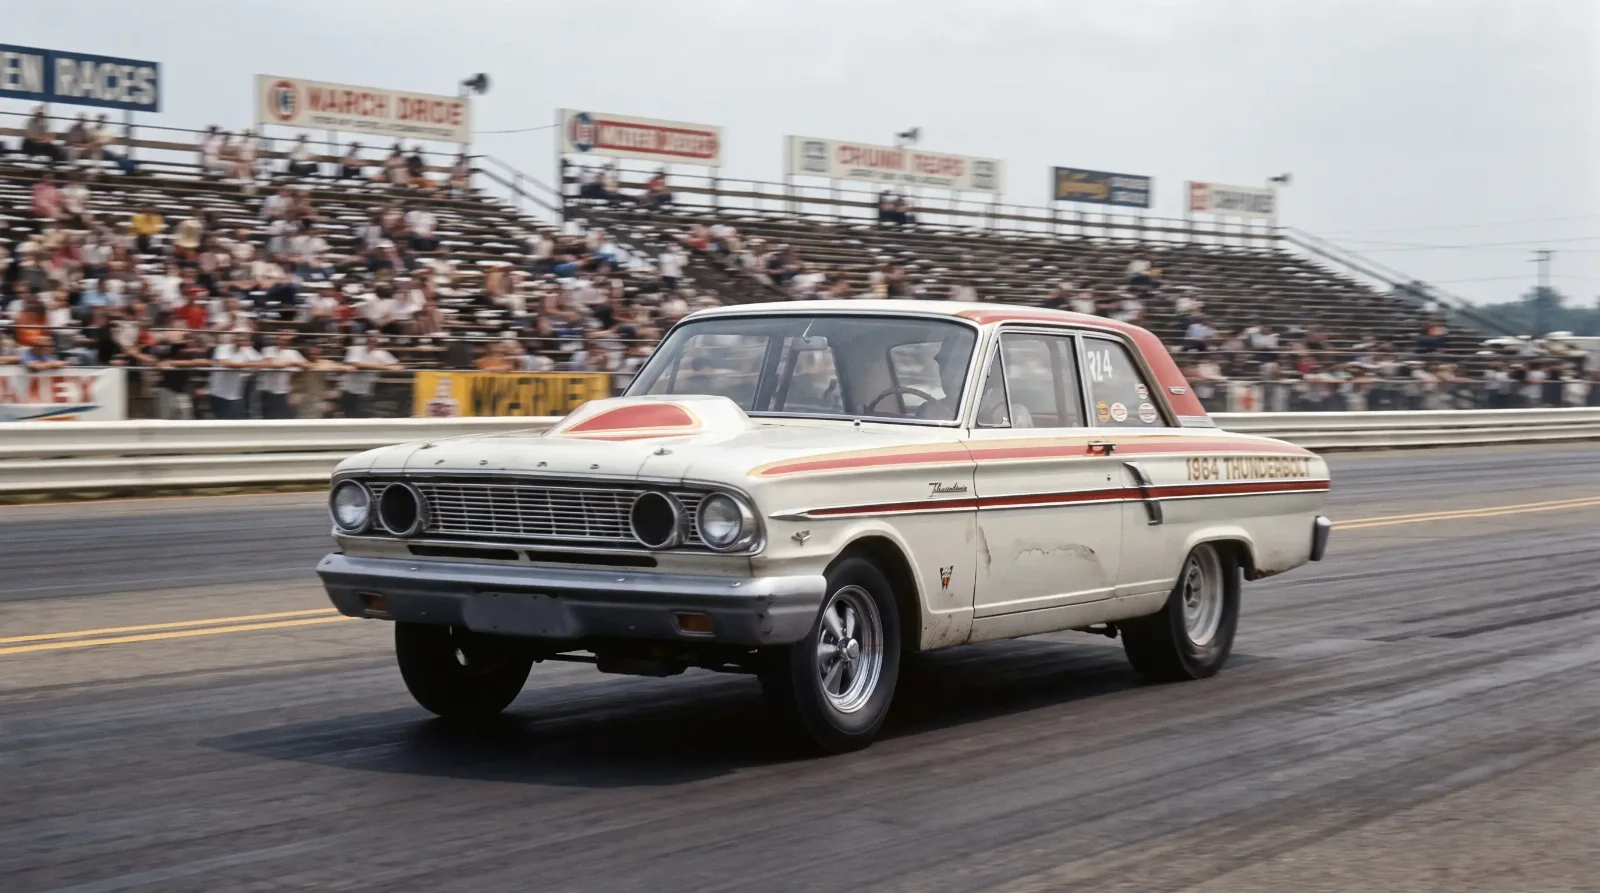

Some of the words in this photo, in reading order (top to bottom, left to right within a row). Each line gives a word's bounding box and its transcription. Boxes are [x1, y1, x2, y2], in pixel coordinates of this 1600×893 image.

[54, 58, 157, 104] RACES
[1186, 457, 1219, 480] 1964
[1223, 456, 1310, 479] THUNDERBOLT
